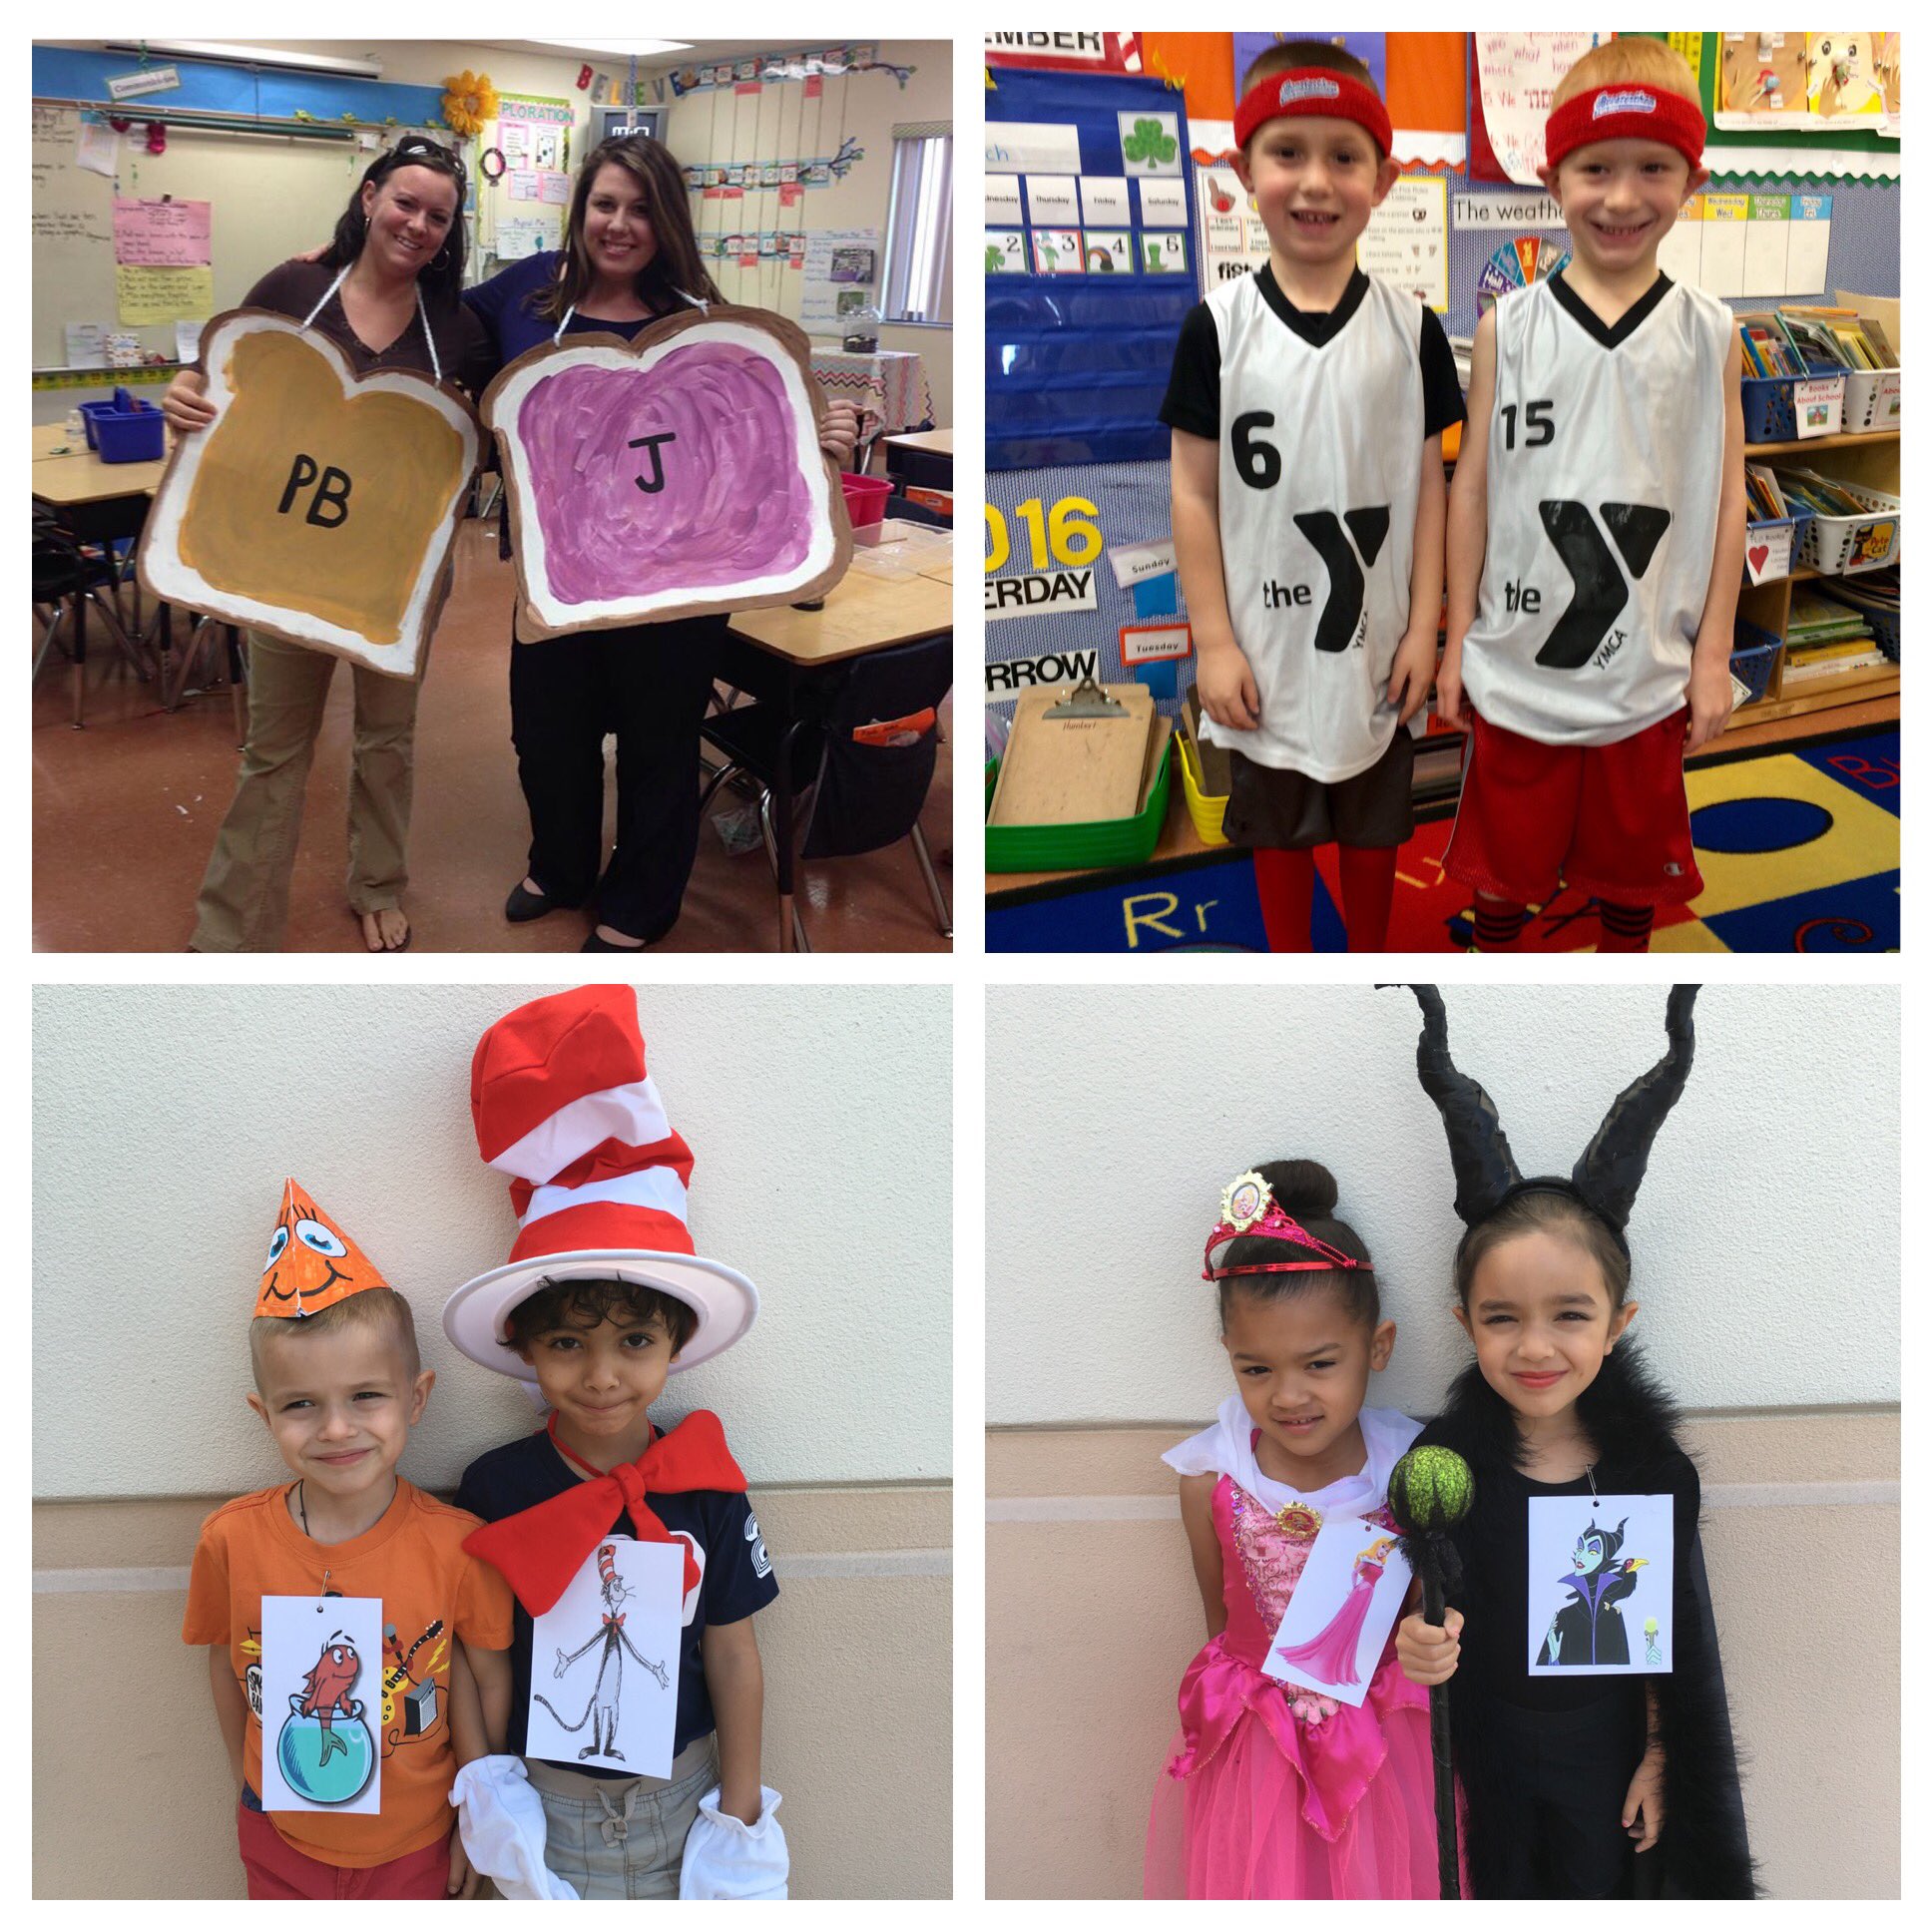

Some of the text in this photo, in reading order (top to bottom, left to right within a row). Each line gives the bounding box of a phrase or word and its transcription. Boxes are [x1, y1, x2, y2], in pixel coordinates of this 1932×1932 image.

[1036, 196, 1070, 205] Thursday
[1094, 197, 1116, 206] Friday
[1148, 197, 1179, 206] Saturday
[1454, 199, 1489, 221] The
[1006, 236, 1020, 251] 2
[1062, 236, 1075, 251] 3
[1113, 237, 1125, 253] 4
[1167, 235, 1179, 252] 5
[1809, 383, 1829, 392] Books
[1796, 392, 1841, 404] About School
[1501, 400, 1555, 450] 15
[1231, 410, 1281, 490] 6
[628, 432, 676, 493] J
[277, 453, 352, 528] PB
[1132, 558, 1170, 574] Sunday
[1262, 580, 1312, 609] the
[1137, 642, 1179, 654] Tuesday
[1593, 629, 1628, 672] YMCA
